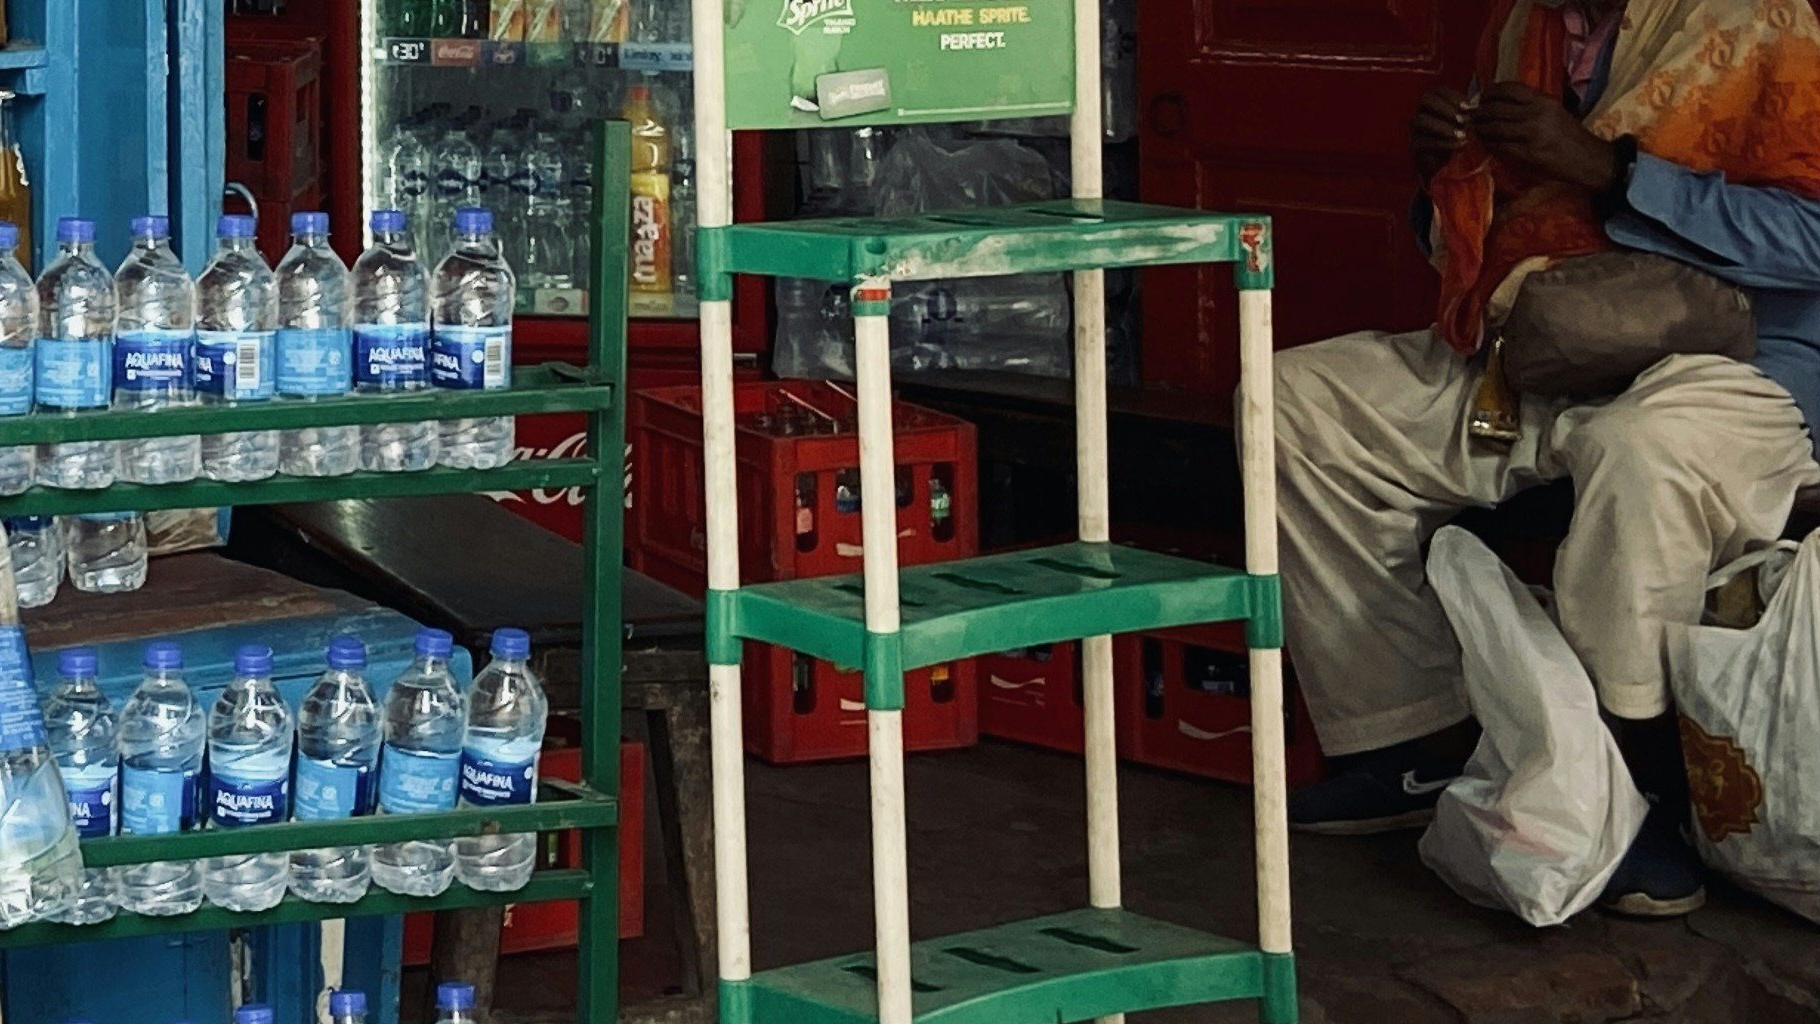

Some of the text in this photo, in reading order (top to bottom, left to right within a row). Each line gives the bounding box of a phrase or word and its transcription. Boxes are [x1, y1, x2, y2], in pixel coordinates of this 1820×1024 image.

[940, 32, 1006, 50] PERFECT.
[125, 352, 184, 371] AQUAFINA
[216, 789, 275, 811] AQUAFINA
